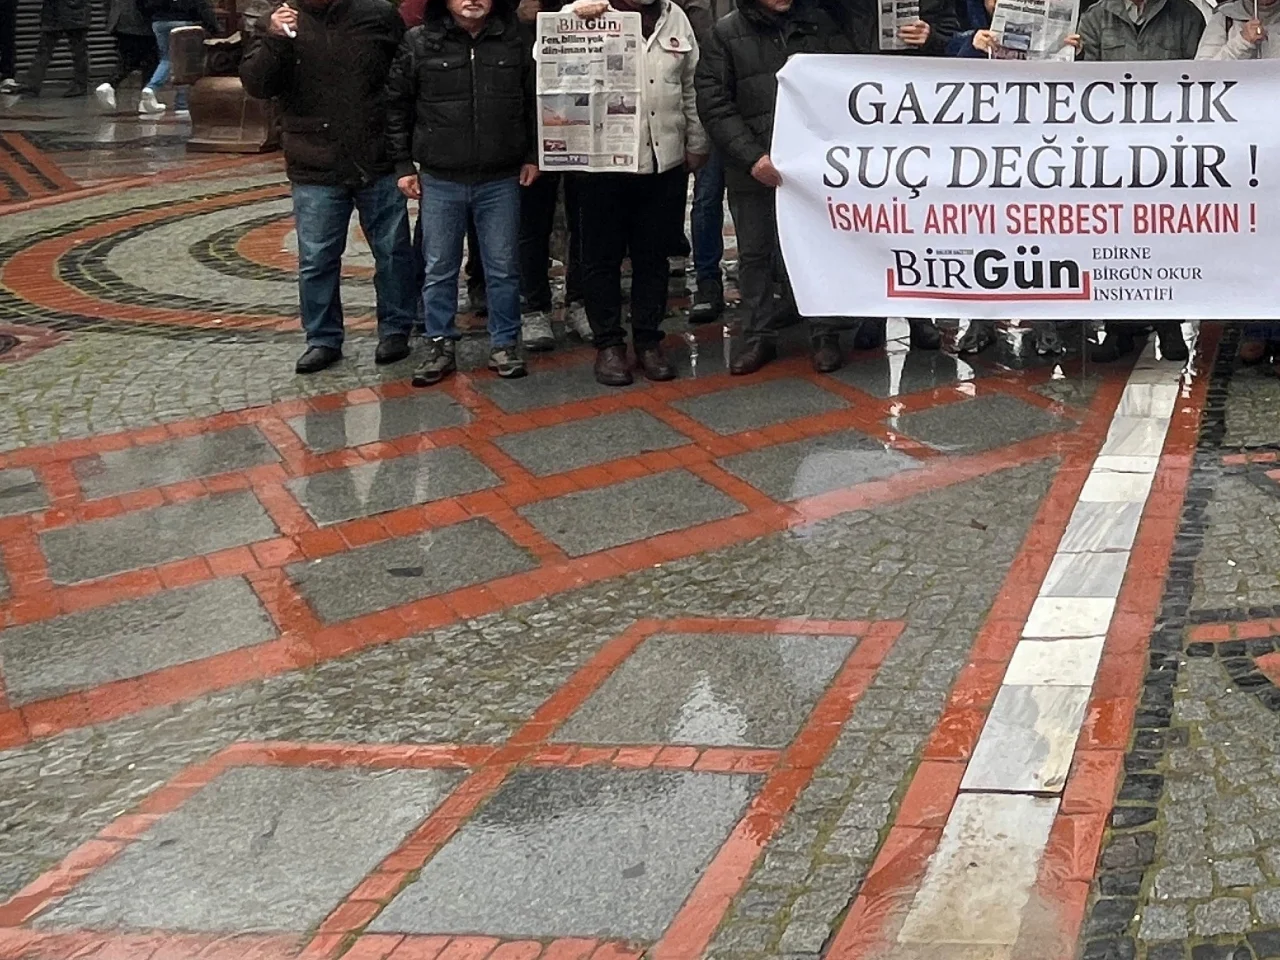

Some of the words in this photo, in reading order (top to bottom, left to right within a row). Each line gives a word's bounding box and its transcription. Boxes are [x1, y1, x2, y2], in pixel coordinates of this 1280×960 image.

[848, 73, 1238, 125] GAZETECİLİK
[822, 145, 932, 199] SUÇ
[946, 134, 1232, 189] DEĞİLDİR
[1250, 145, 1259, 187] !
[827, 196, 914, 235] İSMAİL
[924, 203, 995, 235] ARI'YI
[1006, 203, 1124, 235] SERBEST
[1133, 203, 1239, 234] BIRAKIN
[1249, 203, 1257, 233] !
[1092, 246, 1152, 260] EDİRNE
[1092, 266, 1153, 281] BİRGÜN
[1157, 268, 1203, 281] OKUR
[1092, 285, 1175, 302] İNSİYATİFİ
